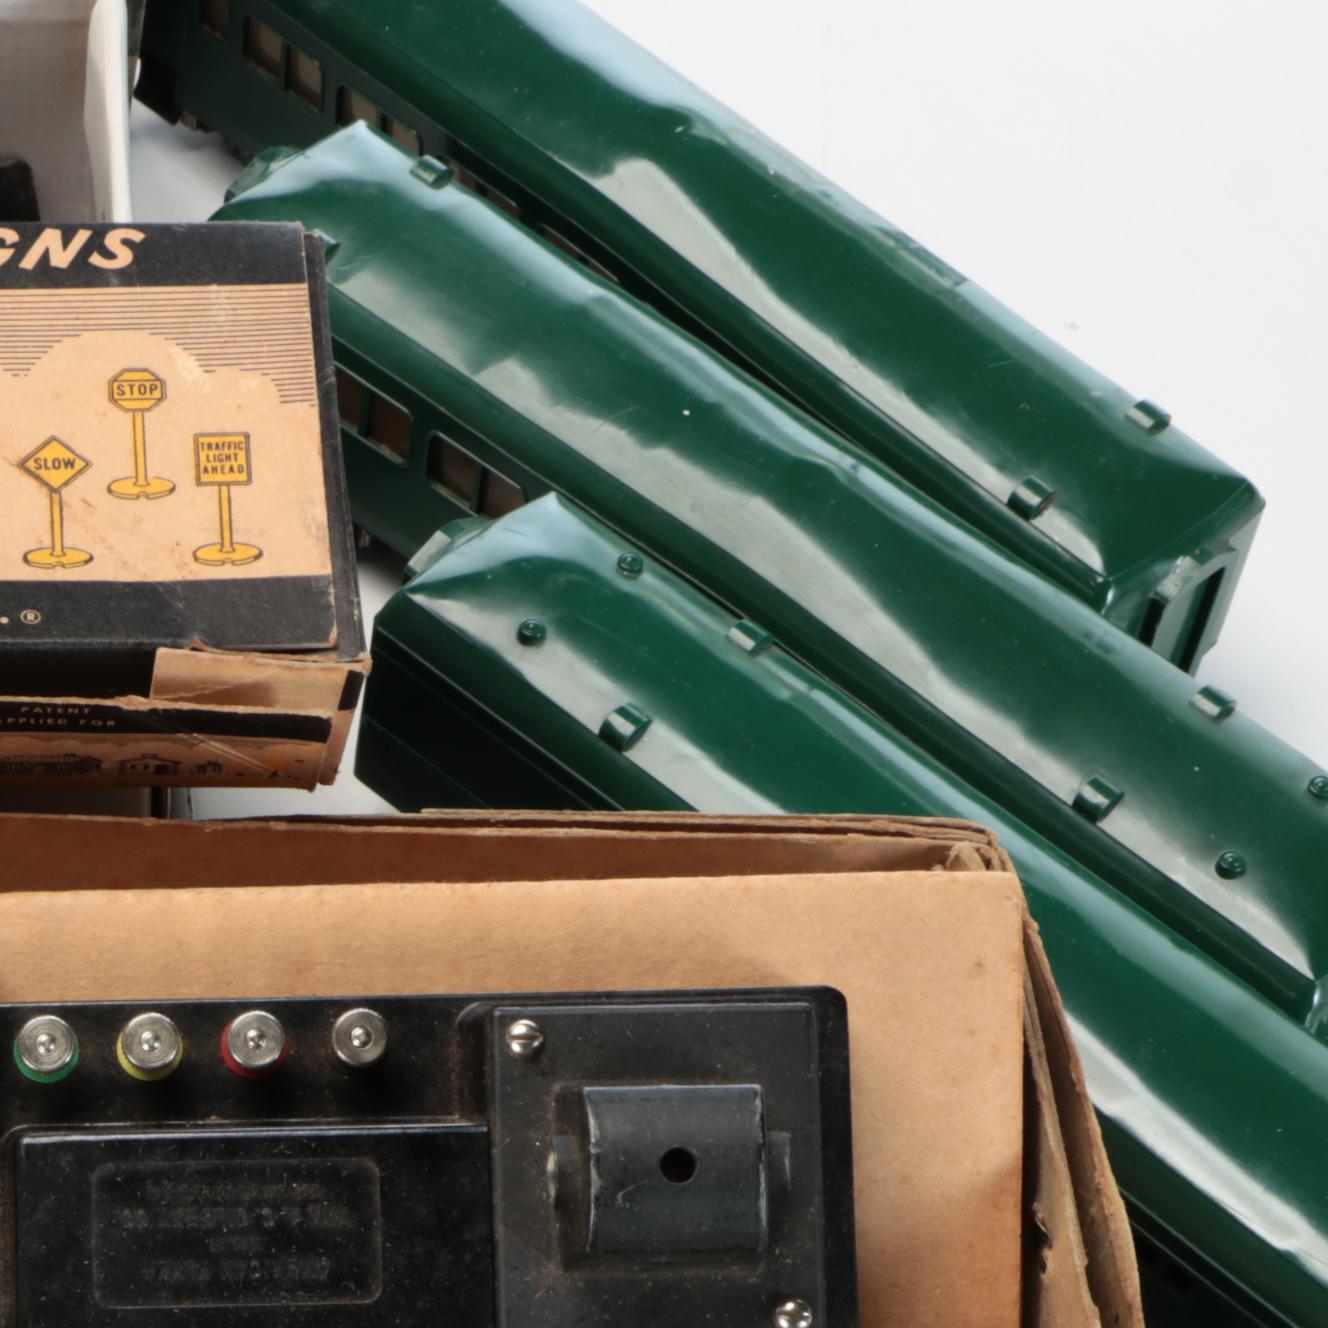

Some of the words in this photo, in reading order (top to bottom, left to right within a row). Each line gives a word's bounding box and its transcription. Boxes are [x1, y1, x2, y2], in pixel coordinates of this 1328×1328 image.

[115, 383, 159, 397] STOP
[199, 441, 245, 451] TRAFFIC
[32, 456, 76, 470] SLOW
[205, 452, 239, 463] LIGHT
[202, 463, 245, 475] AHEAD
[20, 705, 91, 715] PATENT
[78, 718, 117, 727] FOR
